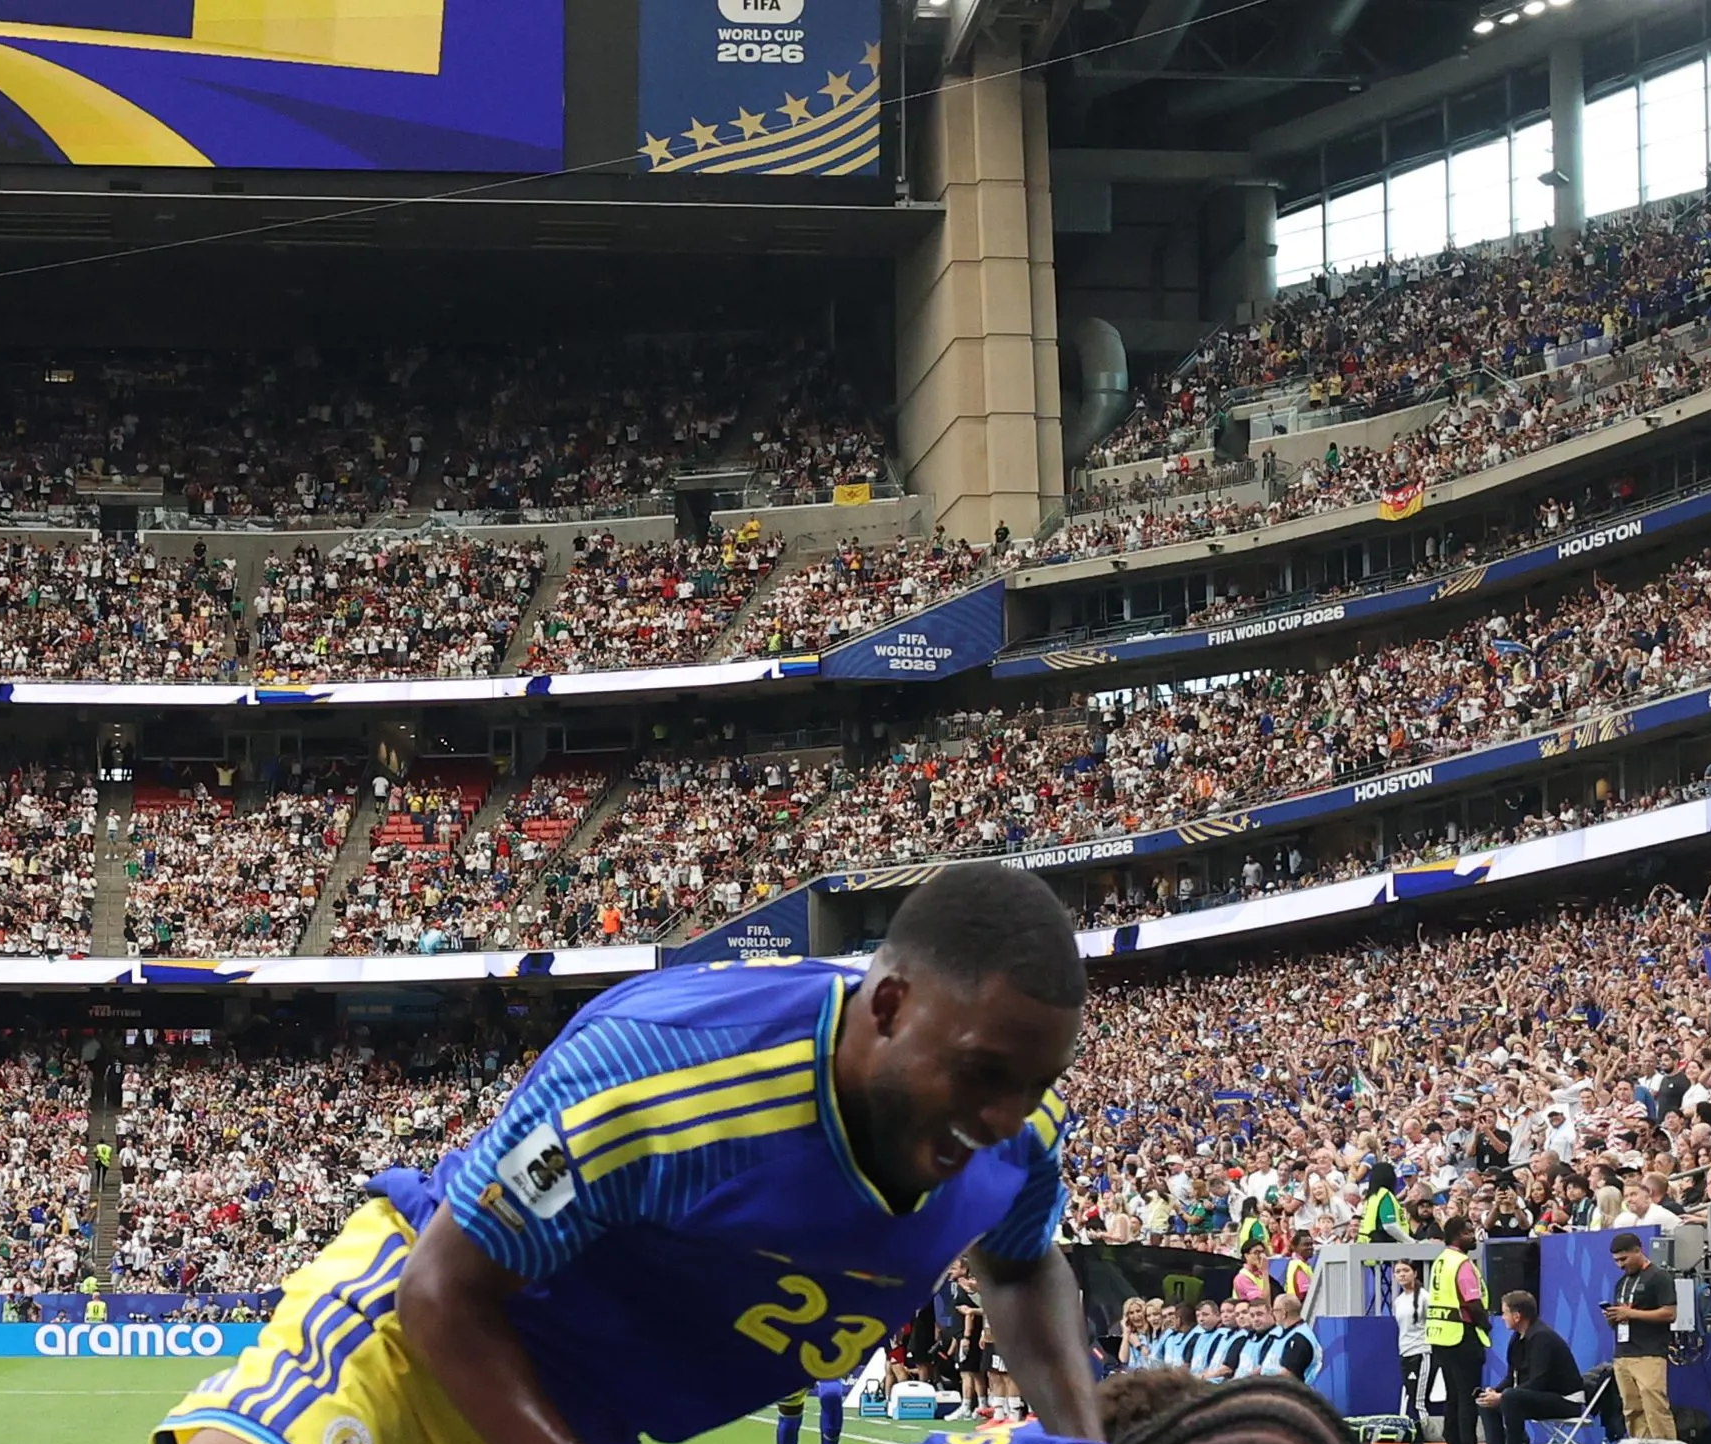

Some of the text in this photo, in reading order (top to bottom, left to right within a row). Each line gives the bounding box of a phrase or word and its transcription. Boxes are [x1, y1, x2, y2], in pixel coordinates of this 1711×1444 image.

[742, 0, 781, 11] FIFA
[717, 28, 804, 42] WORLD CUP
[717, 42, 805, 64] 2026
[1558, 520, 1642, 560] HOUSTON
[1208, 605, 1346, 646] FIFA WORLD CUP 2026
[898, 633, 928, 646] FIFA
[874, 645, 953, 659] WORLD CUP
[889, 658, 937, 671] 2026
[1354, 767, 1433, 803] HOUSTON
[1025, 850, 1067, 869] WORLD
[1068, 846, 1091, 863] CUP
[1092, 840, 1134, 860] 2026
[746, 925, 771, 936] FIFA
[727, 937, 792, 948] WORLD CUP
[740, 949, 780, 959] 2026
[734, 1274, 888, 1379] 23
[34, 1324, 224, 1357] aramco
